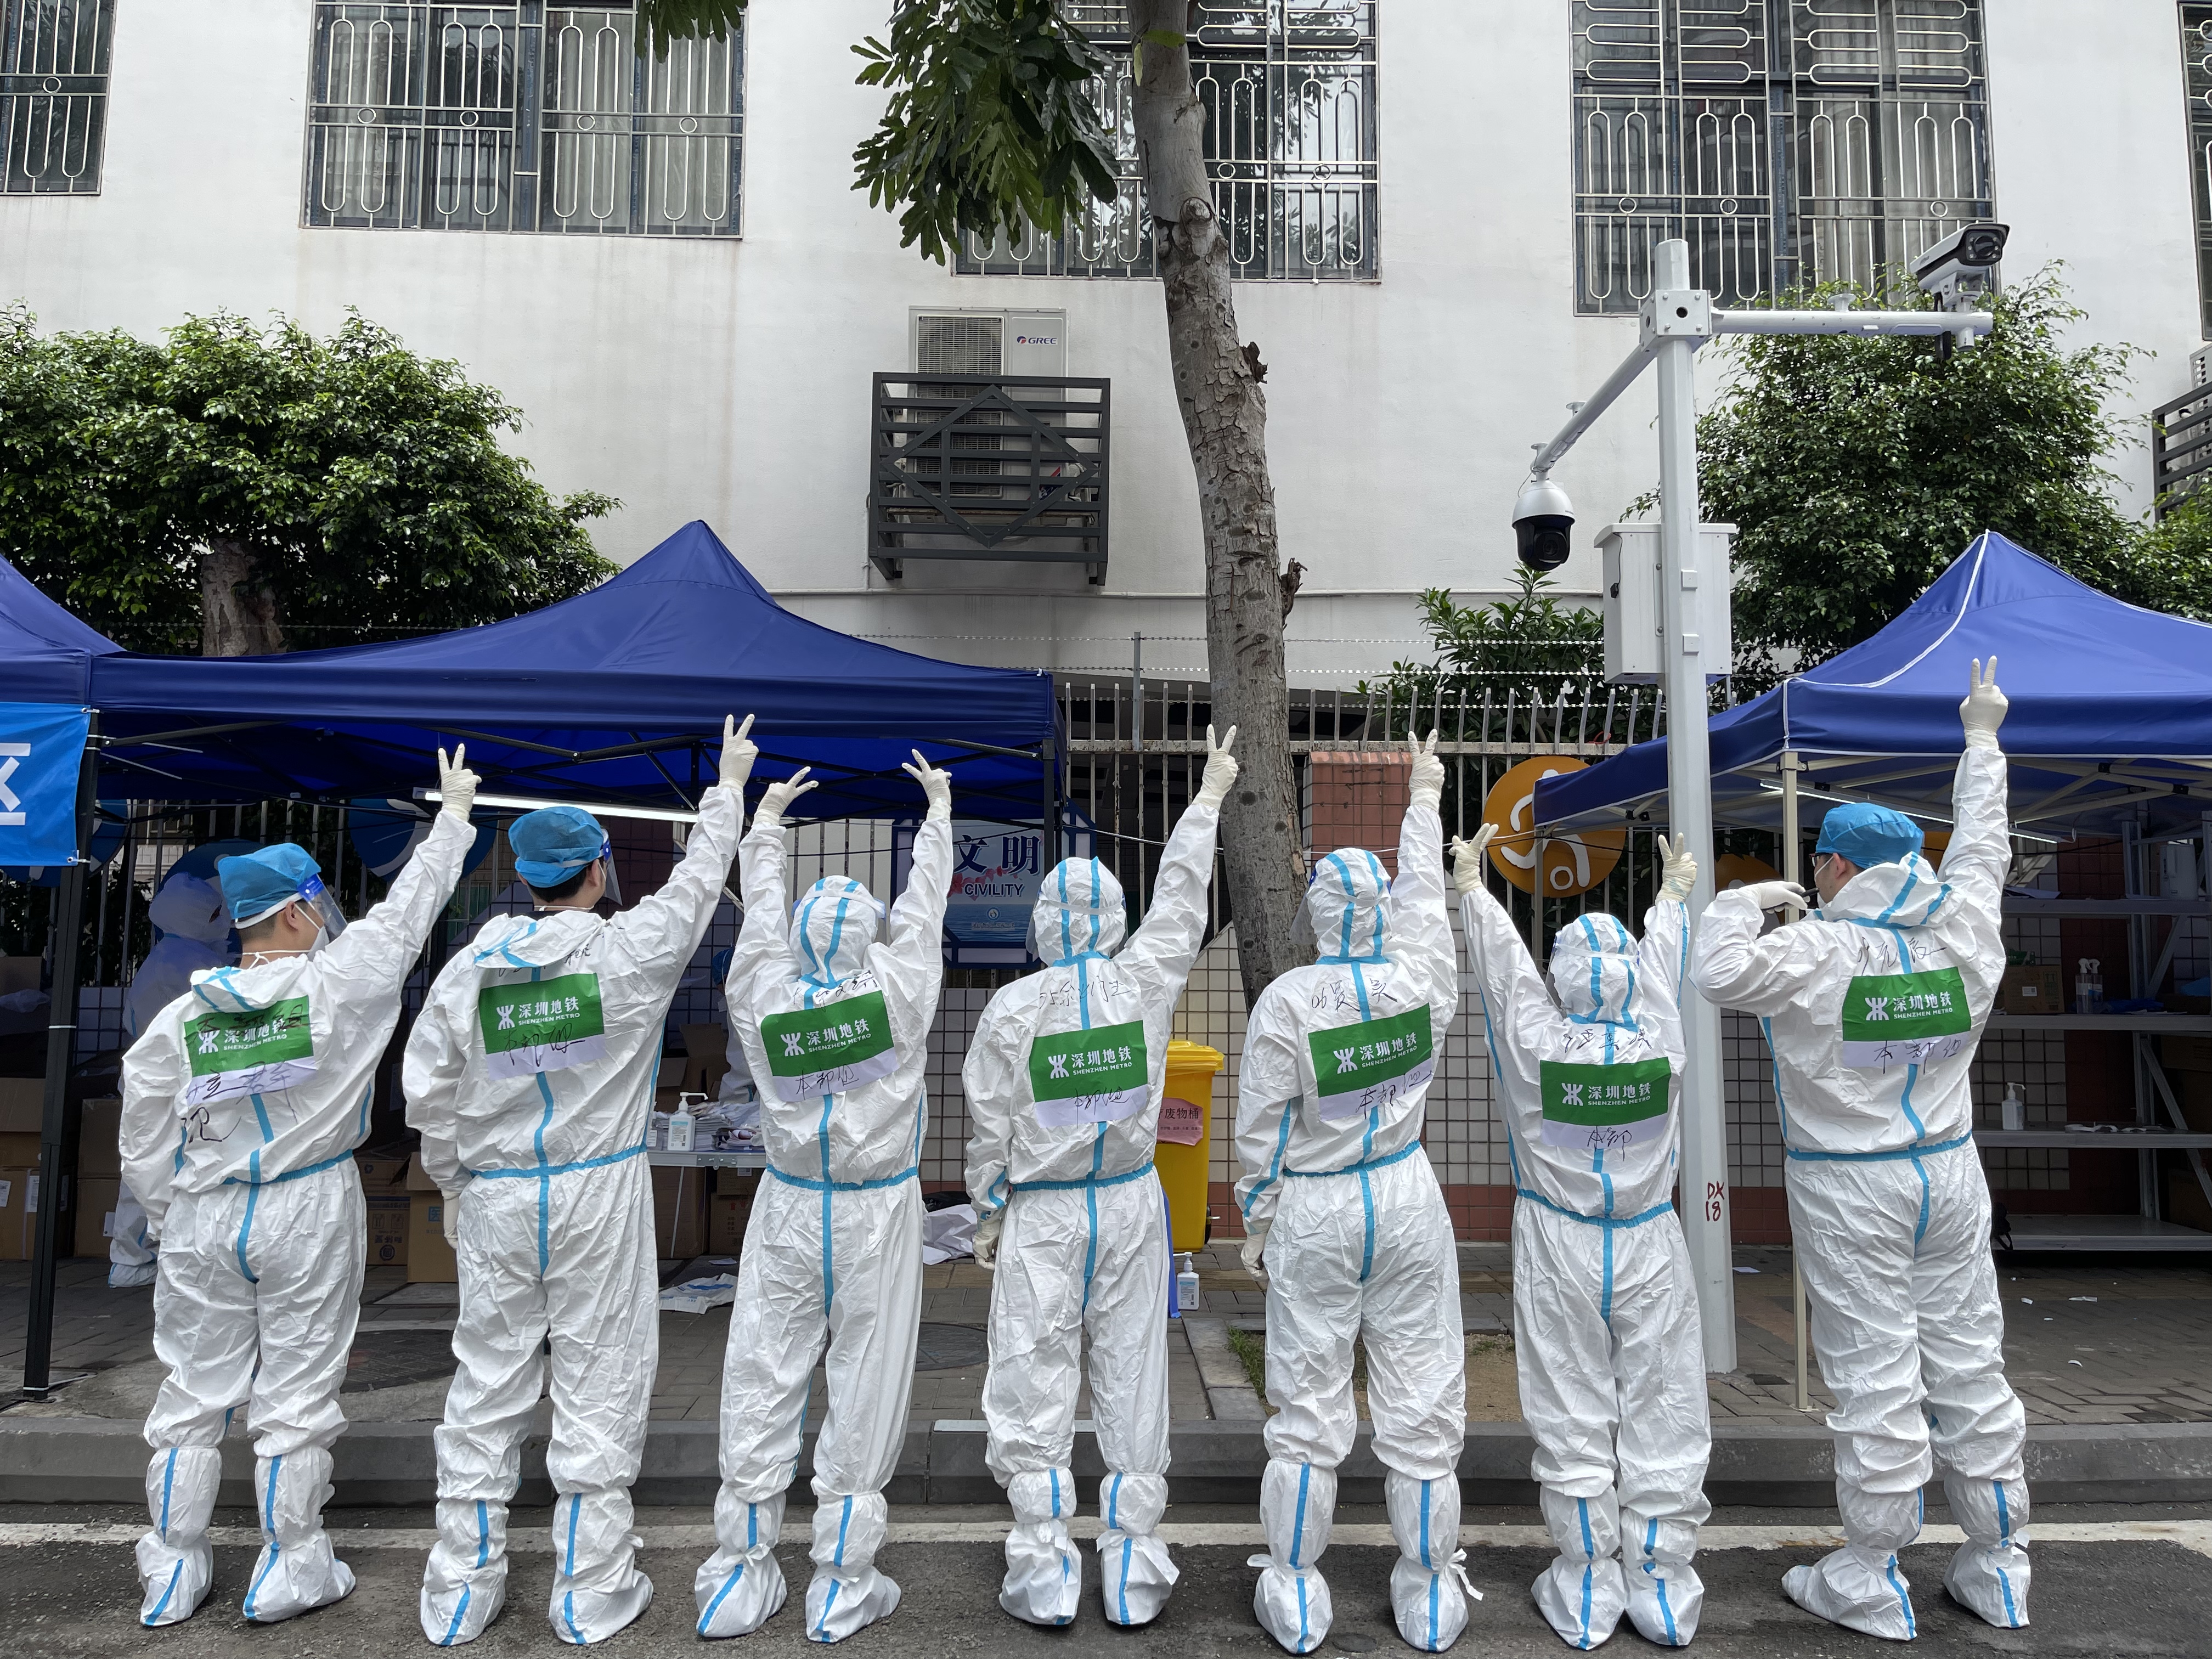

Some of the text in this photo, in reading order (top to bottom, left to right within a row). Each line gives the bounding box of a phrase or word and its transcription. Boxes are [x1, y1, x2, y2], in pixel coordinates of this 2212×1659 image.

[953, 835, 1041, 875] 文明
[964, 884, 1024, 896] CIVILITY
[518, 996, 580, 1019] 深圳地铁
[1893, 991, 1951, 1012] 深圳地铁
[518, 1016, 555, 1026] SHENZHEN
[1894, 1011, 1931, 1019] SHENZHEN
[224, 1019, 286, 1043] 深圳地铁
[806, 1018, 870, 1046] 深圳地铁
[223, 1034, 287, 1051] SHENZHEN METRO
[808, 1033, 871, 1053] SHENZHEN METRO
[1359, 1032, 1417, 1061] 深圳地铁
[1071, 1046, 1131, 1069] 深圳地铁
[1362, 1046, 1418, 1068] SHENZHEN METRO
[1073, 1062, 1132, 1075] SHENZHEN METRO
[1588, 1082, 1651, 1099] 深圳地铁
[1628, 1096, 1651, 1104] METRO
[1707, 1181, 1725, 1200] DX
[1706, 1200, 1721, 1222] 18
